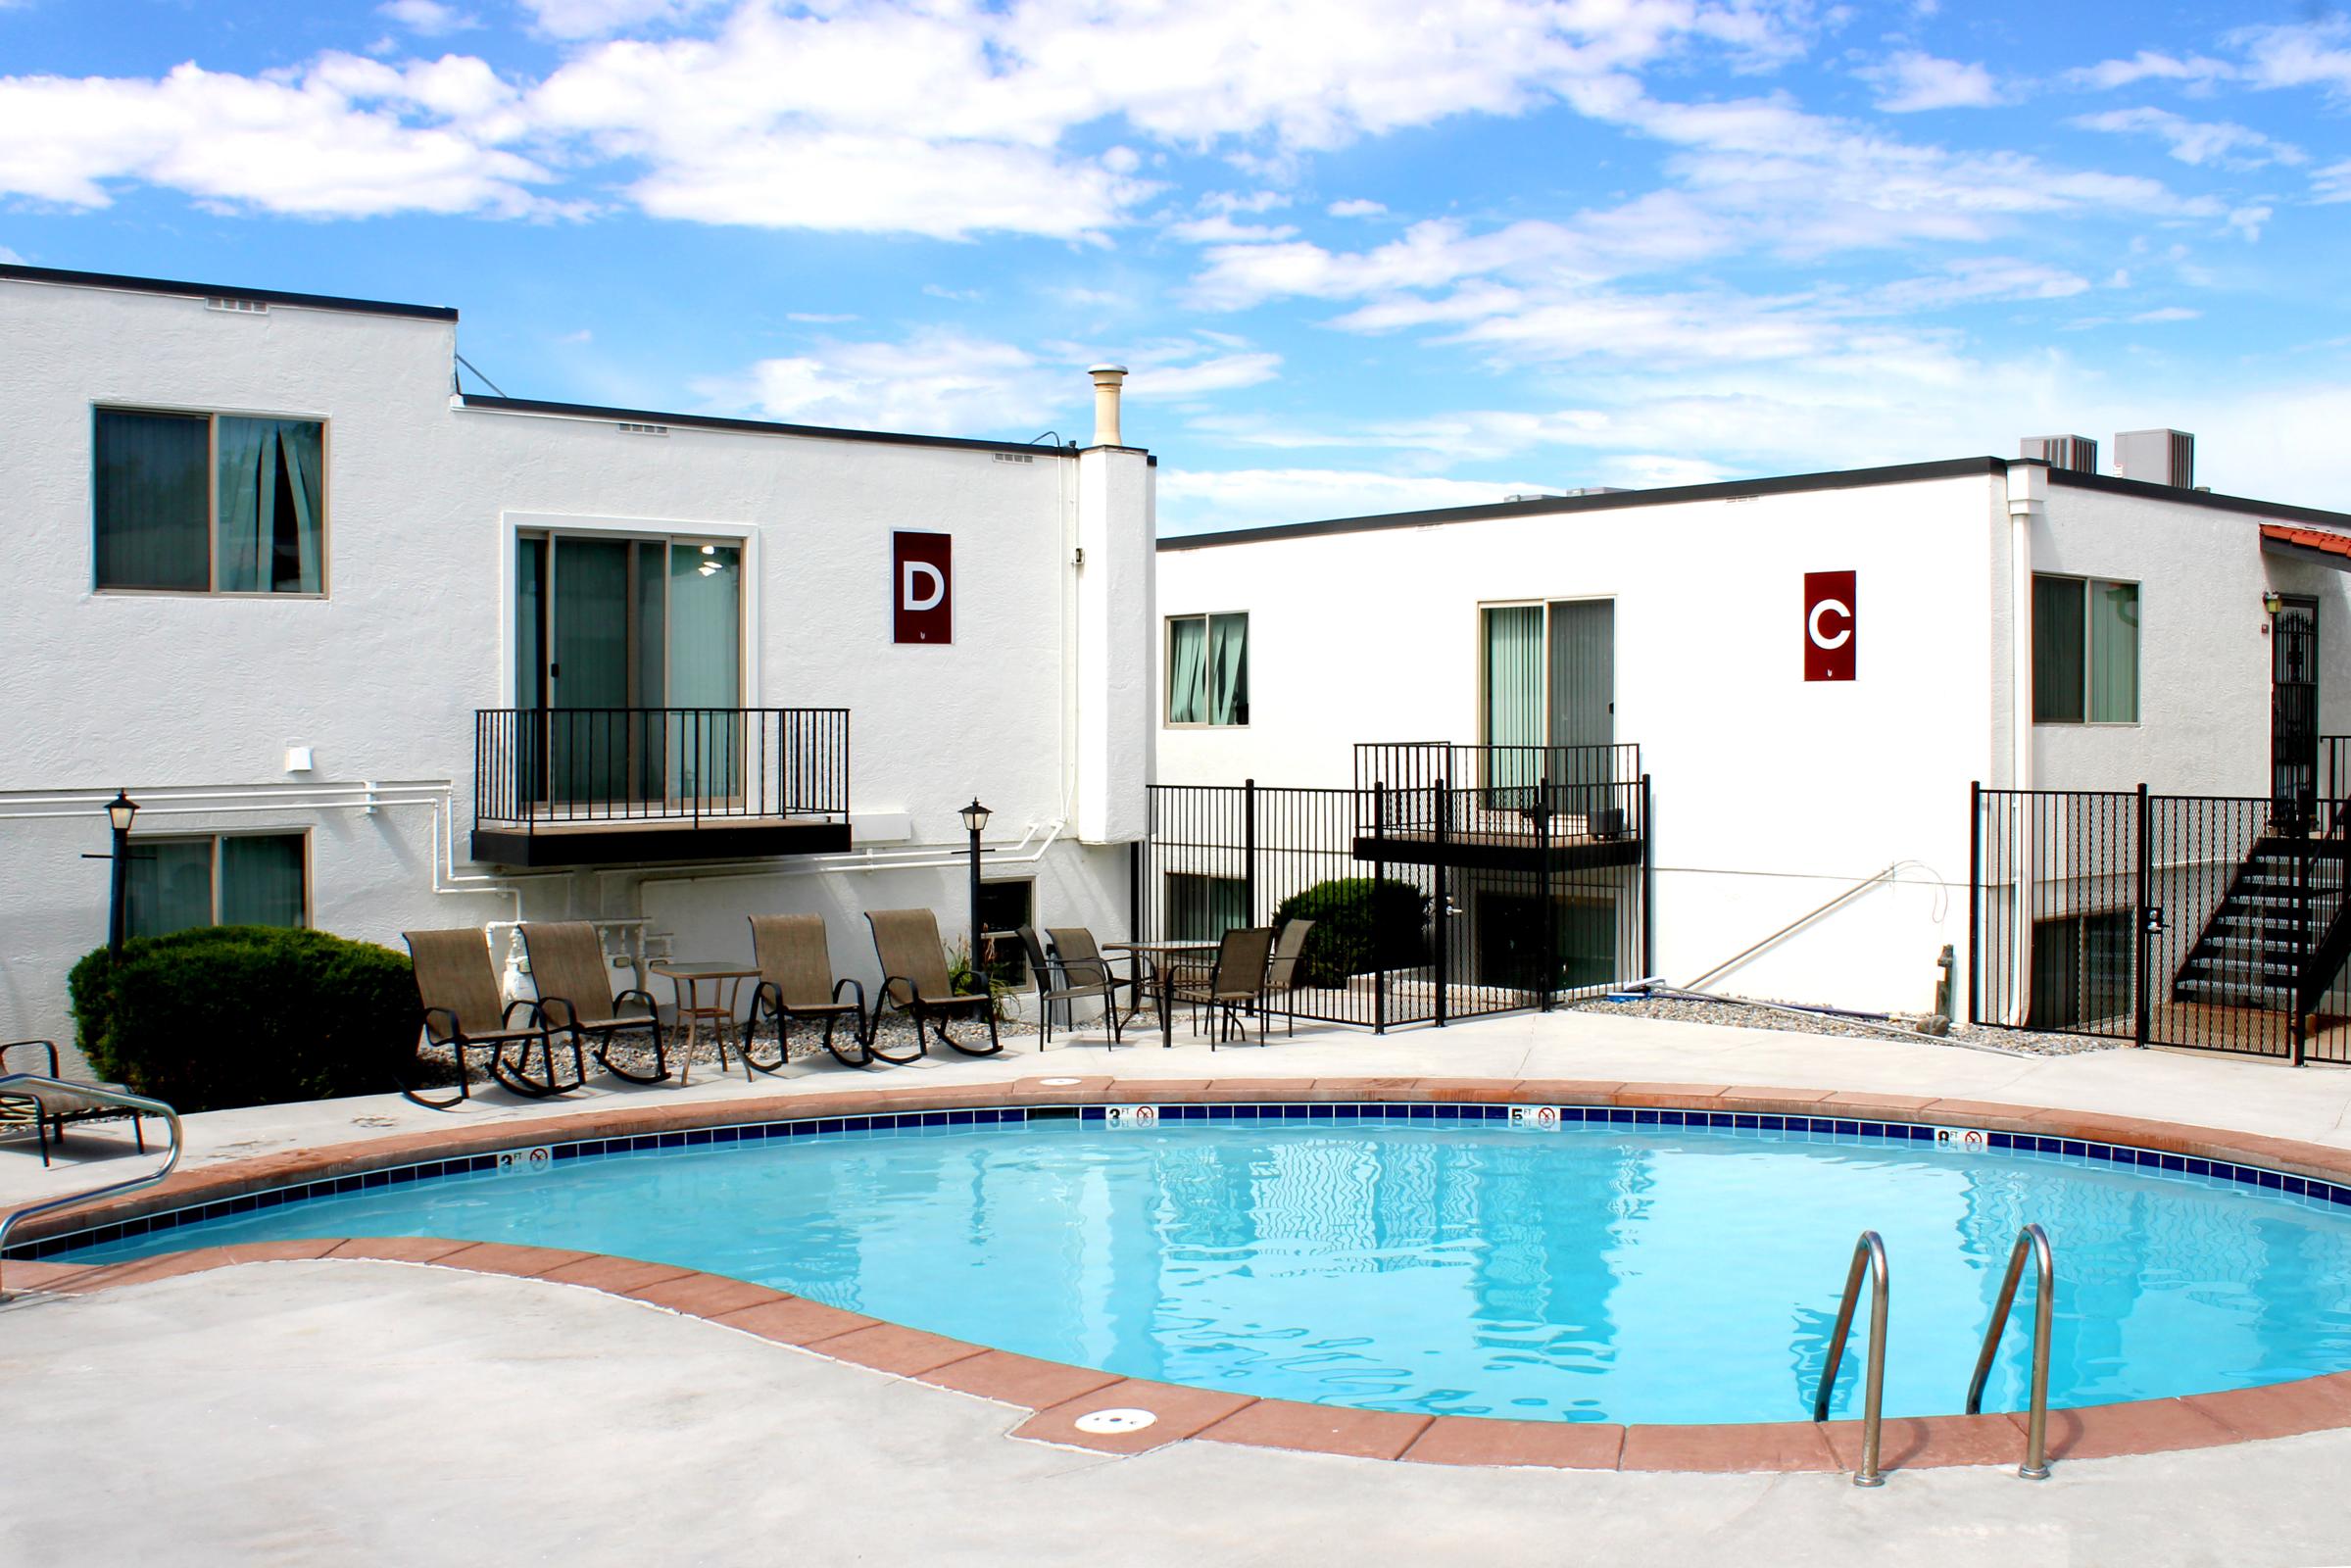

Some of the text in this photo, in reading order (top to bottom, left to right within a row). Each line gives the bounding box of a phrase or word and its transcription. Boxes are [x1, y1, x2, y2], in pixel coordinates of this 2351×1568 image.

[904, 561, 945, 611] D
[1808, 598, 1851, 650] C
[1512, 1108, 1523, 1119] 5
